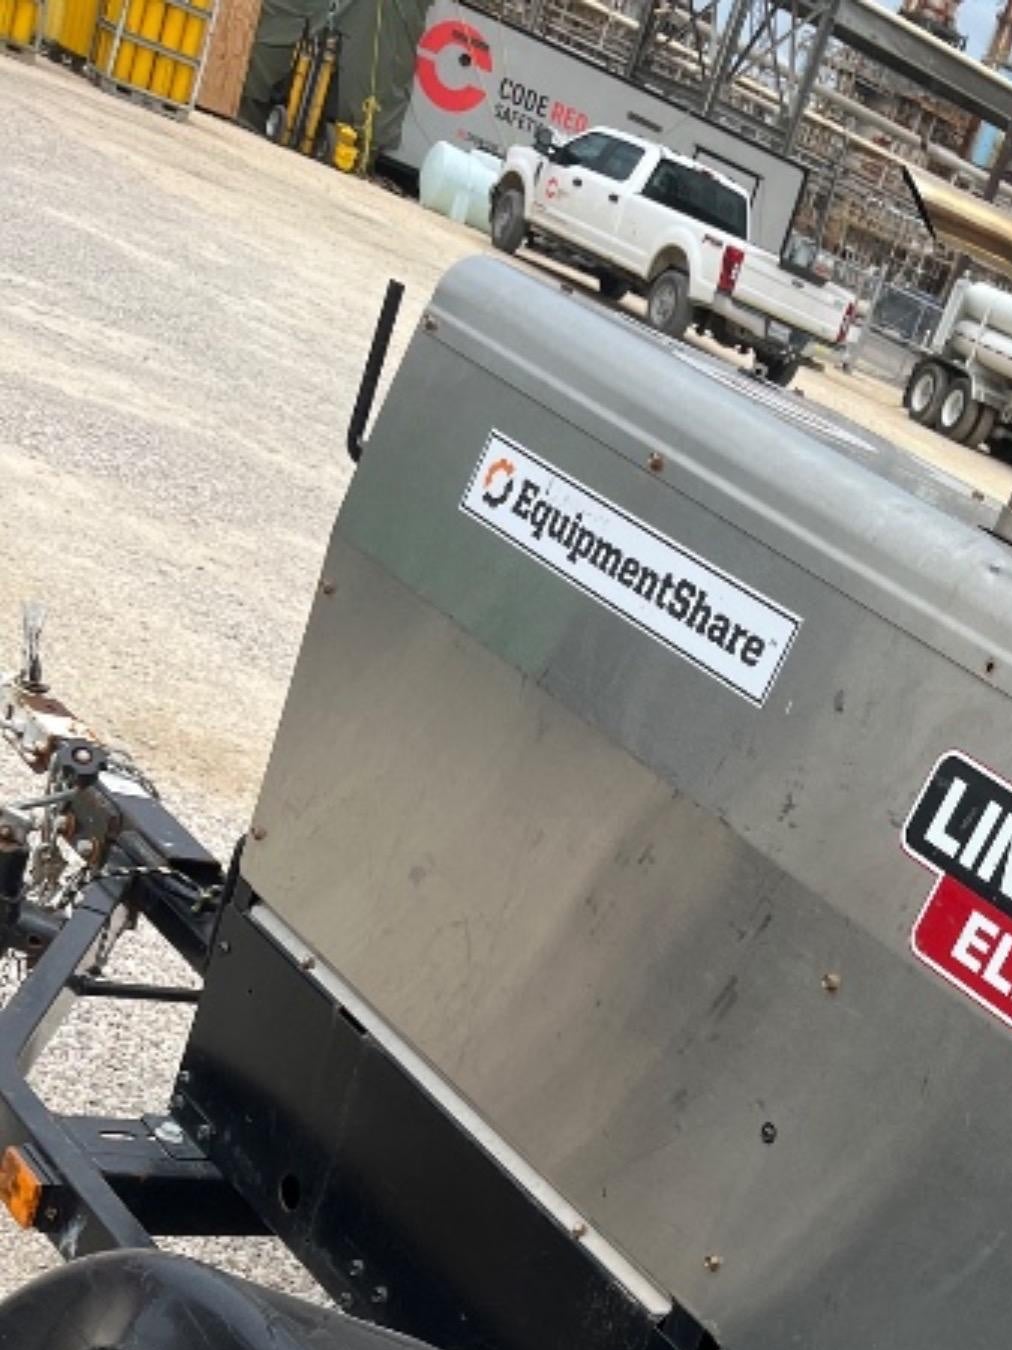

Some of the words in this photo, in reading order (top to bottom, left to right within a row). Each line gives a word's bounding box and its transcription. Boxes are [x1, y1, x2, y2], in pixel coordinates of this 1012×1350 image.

[500, 77, 549, 118] CODE
[551, 101, 589, 133] RED
[511, 478, 766, 667] EquipmentShare
